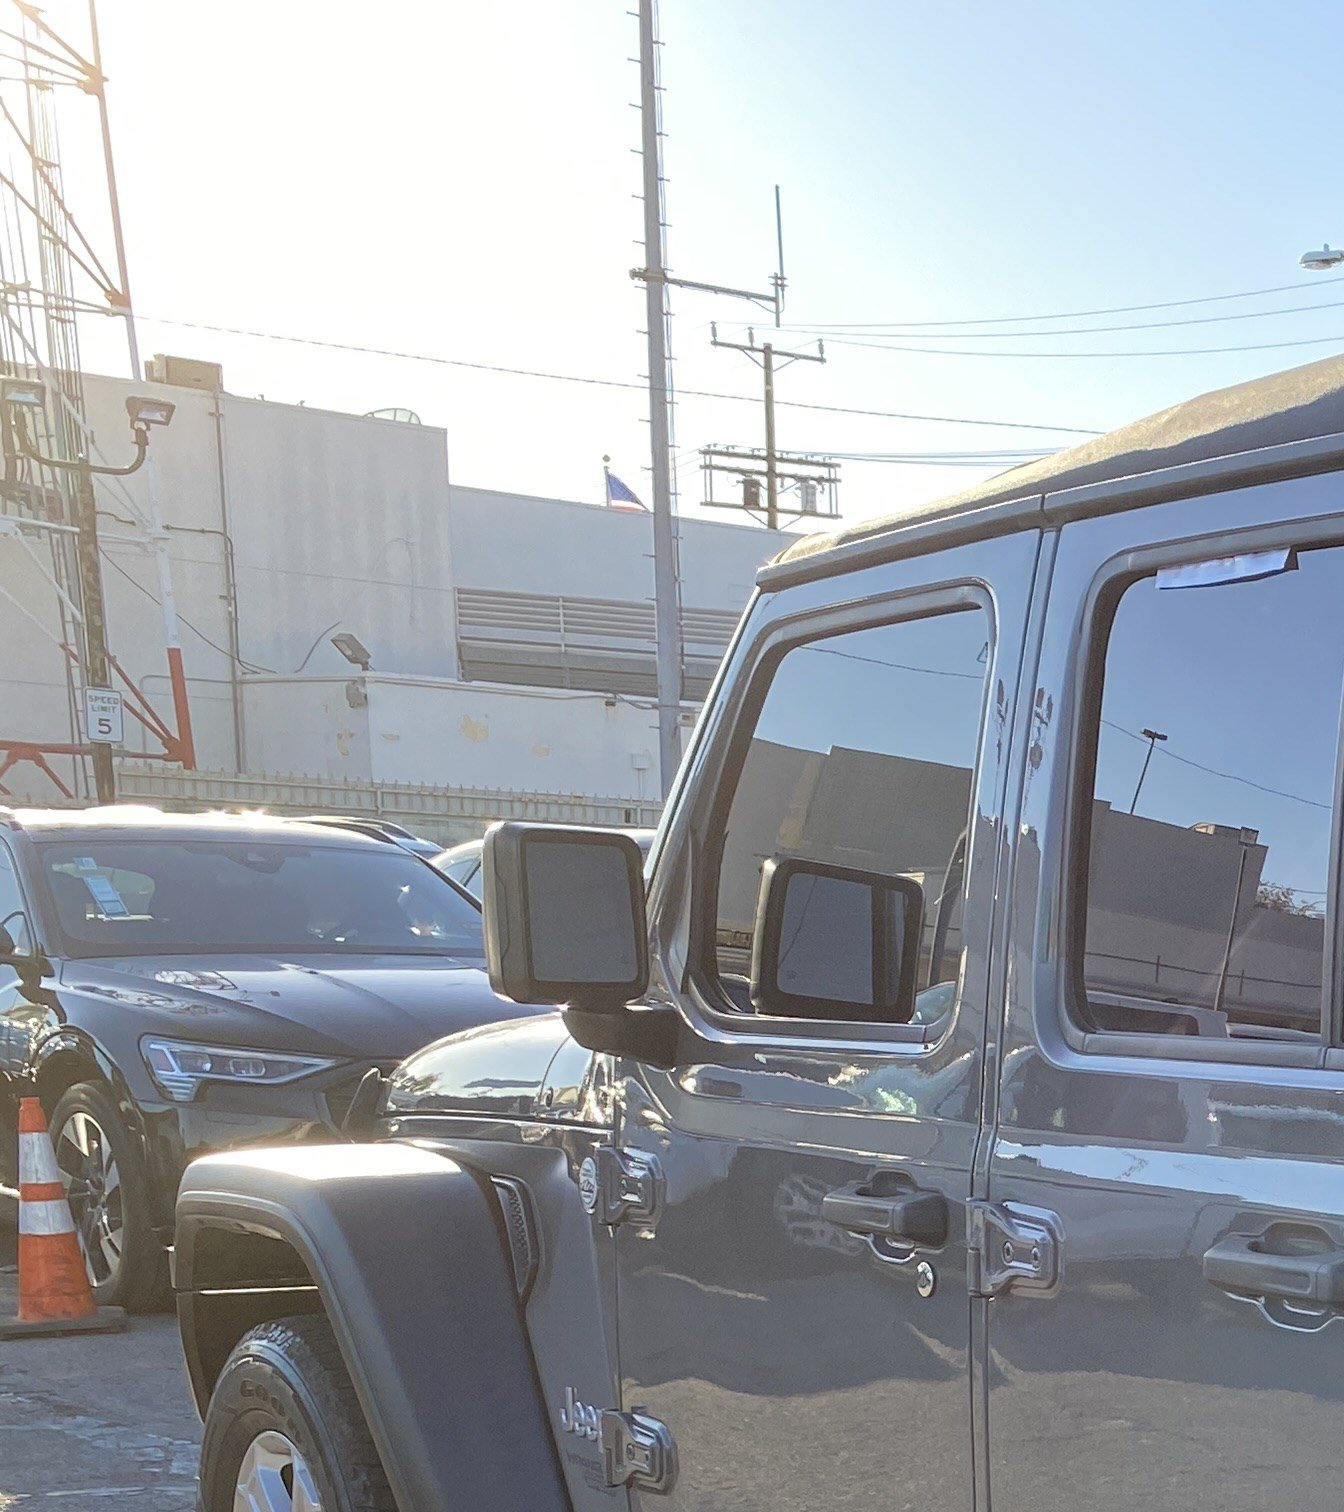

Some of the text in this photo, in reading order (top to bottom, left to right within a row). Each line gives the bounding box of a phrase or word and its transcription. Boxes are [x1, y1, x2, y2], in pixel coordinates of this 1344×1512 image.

[88, 695, 119, 704] SPEED
[91, 705, 117, 713] LIMIT
[98, 717, 112, 735] 5
